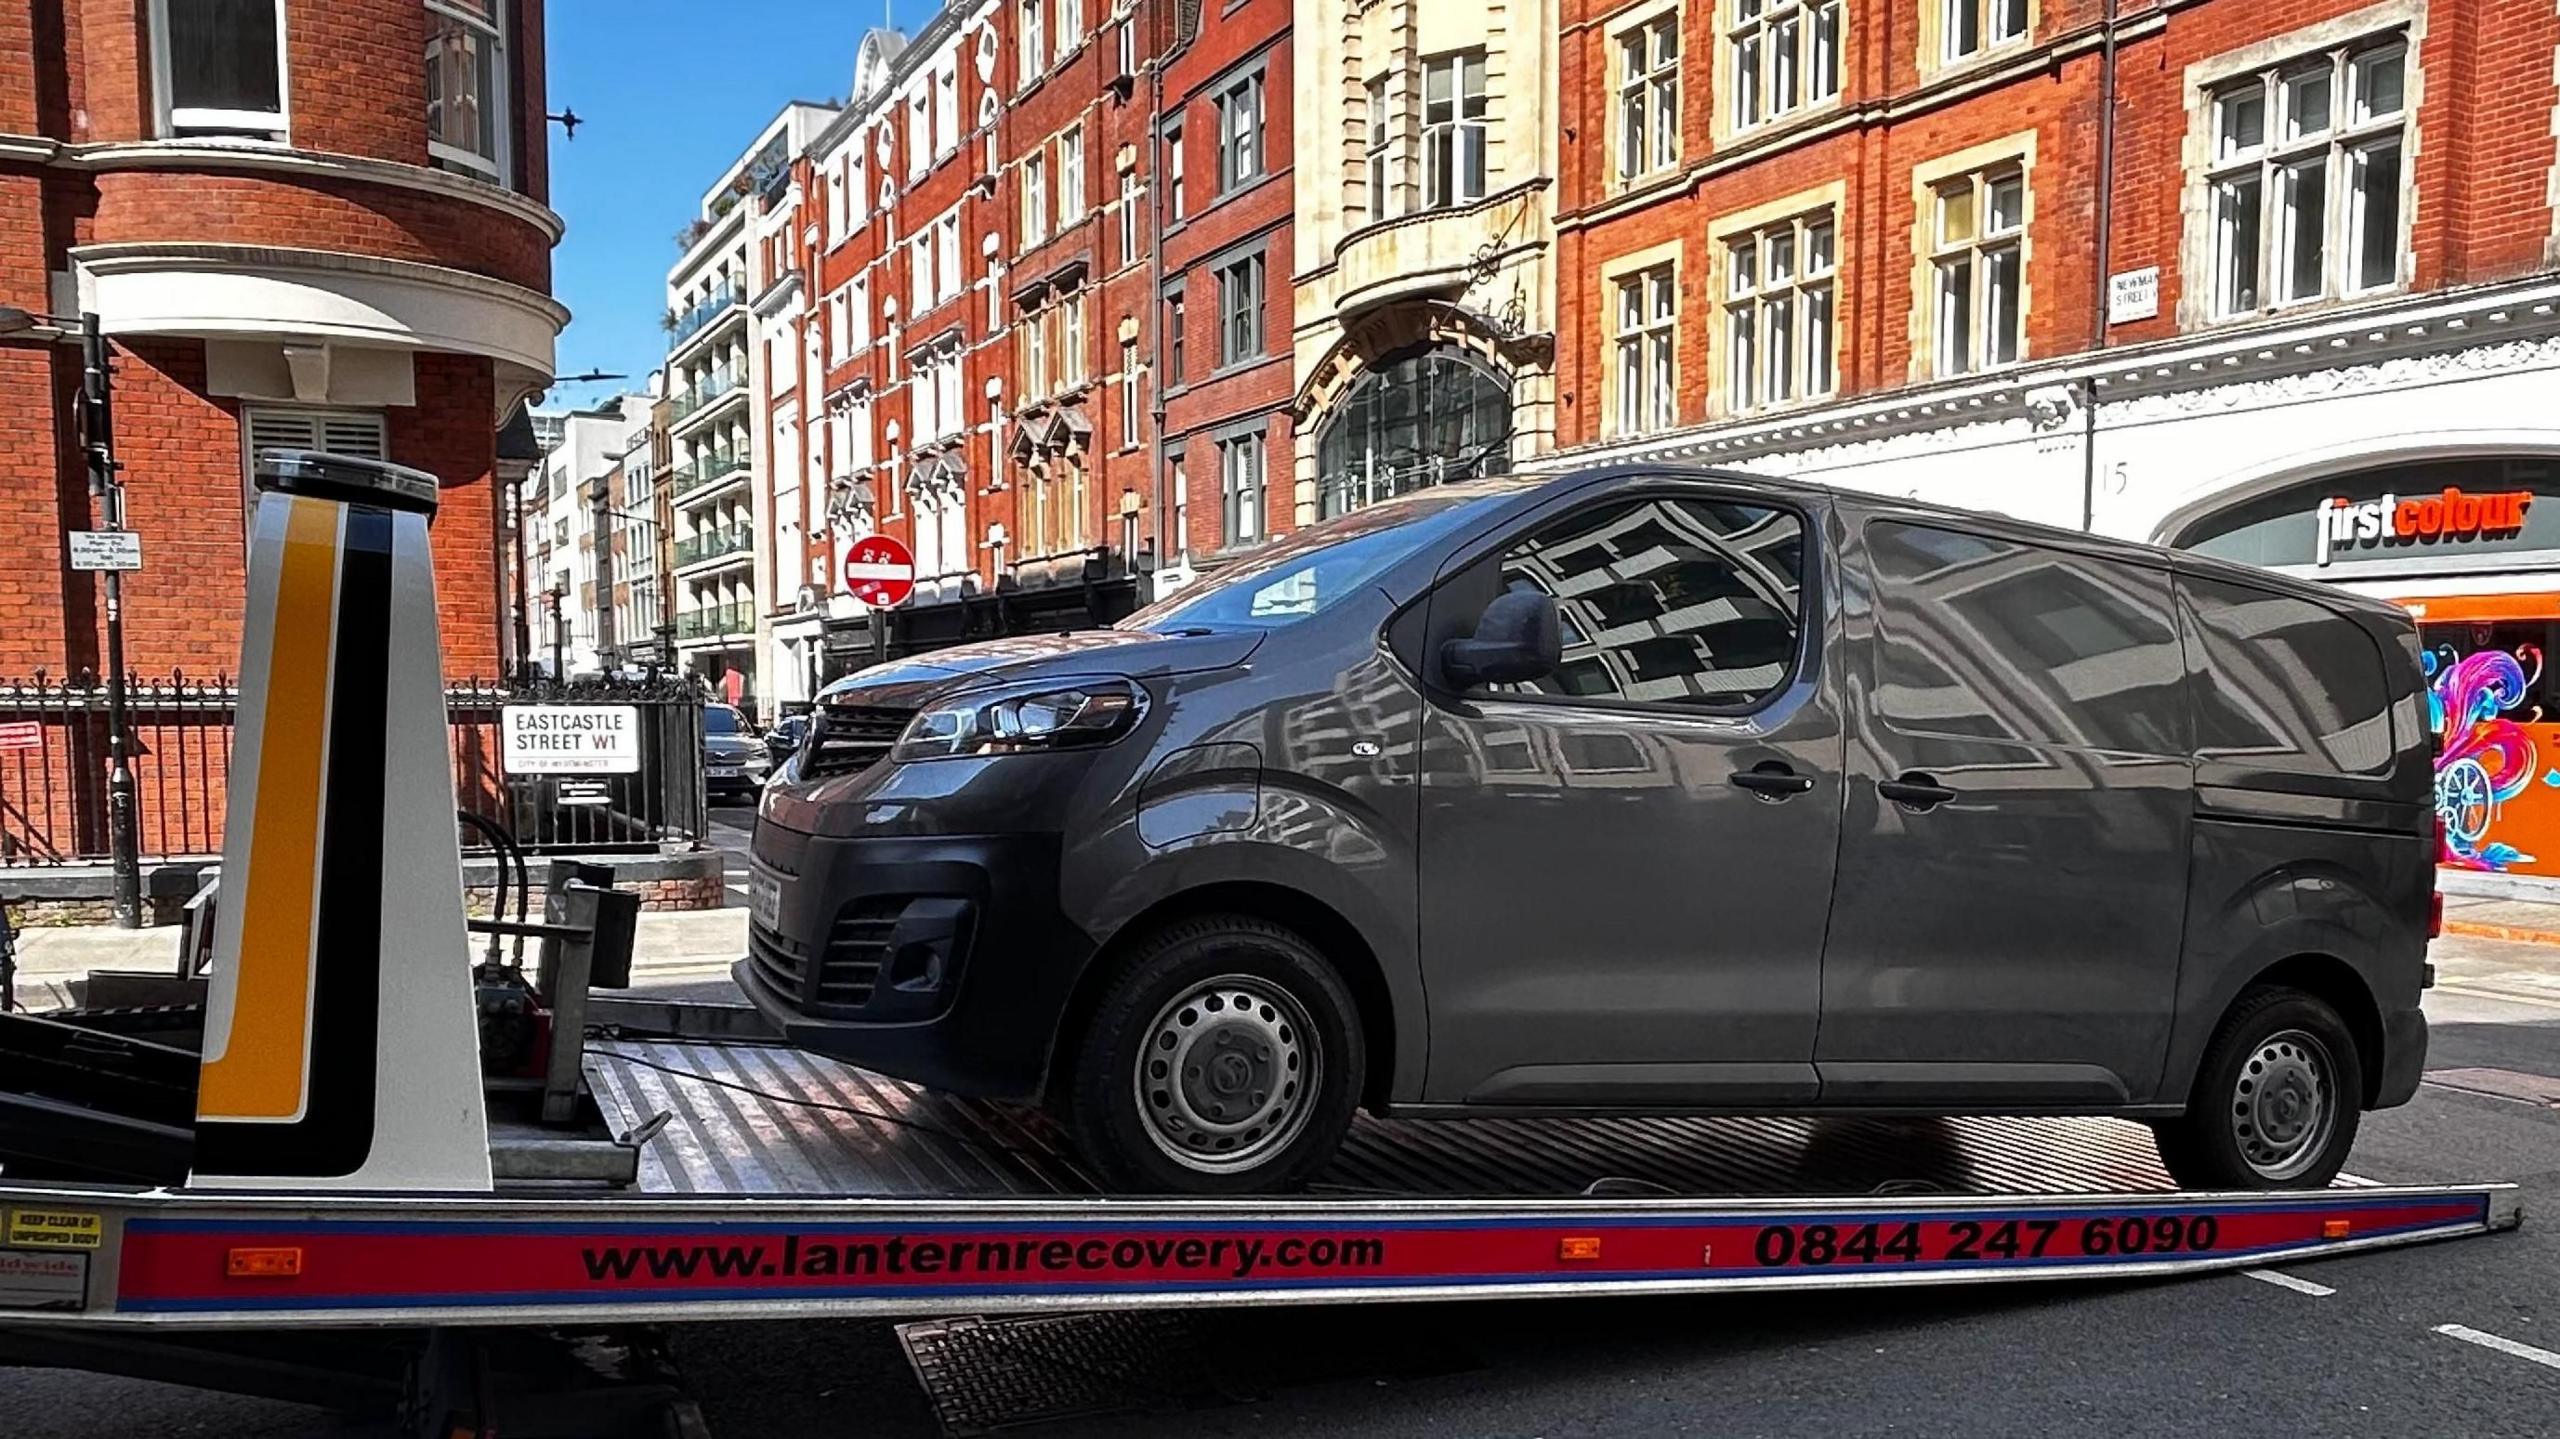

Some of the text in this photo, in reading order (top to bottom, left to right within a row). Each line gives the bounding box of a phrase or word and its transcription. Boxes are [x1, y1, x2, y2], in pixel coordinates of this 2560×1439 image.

[2316, 487, 2535, 566] firstcolour
[516, 714, 623, 730] EASTCASTLE
[516, 733, 616, 750] STREET W1
[20, 1214, 94, 1229] KEEP CLEAR OF
[1753, 1215, 2218, 1267] 0844 247 6090
[581, 1234, 1384, 1281] www.lanternrecovery.com
